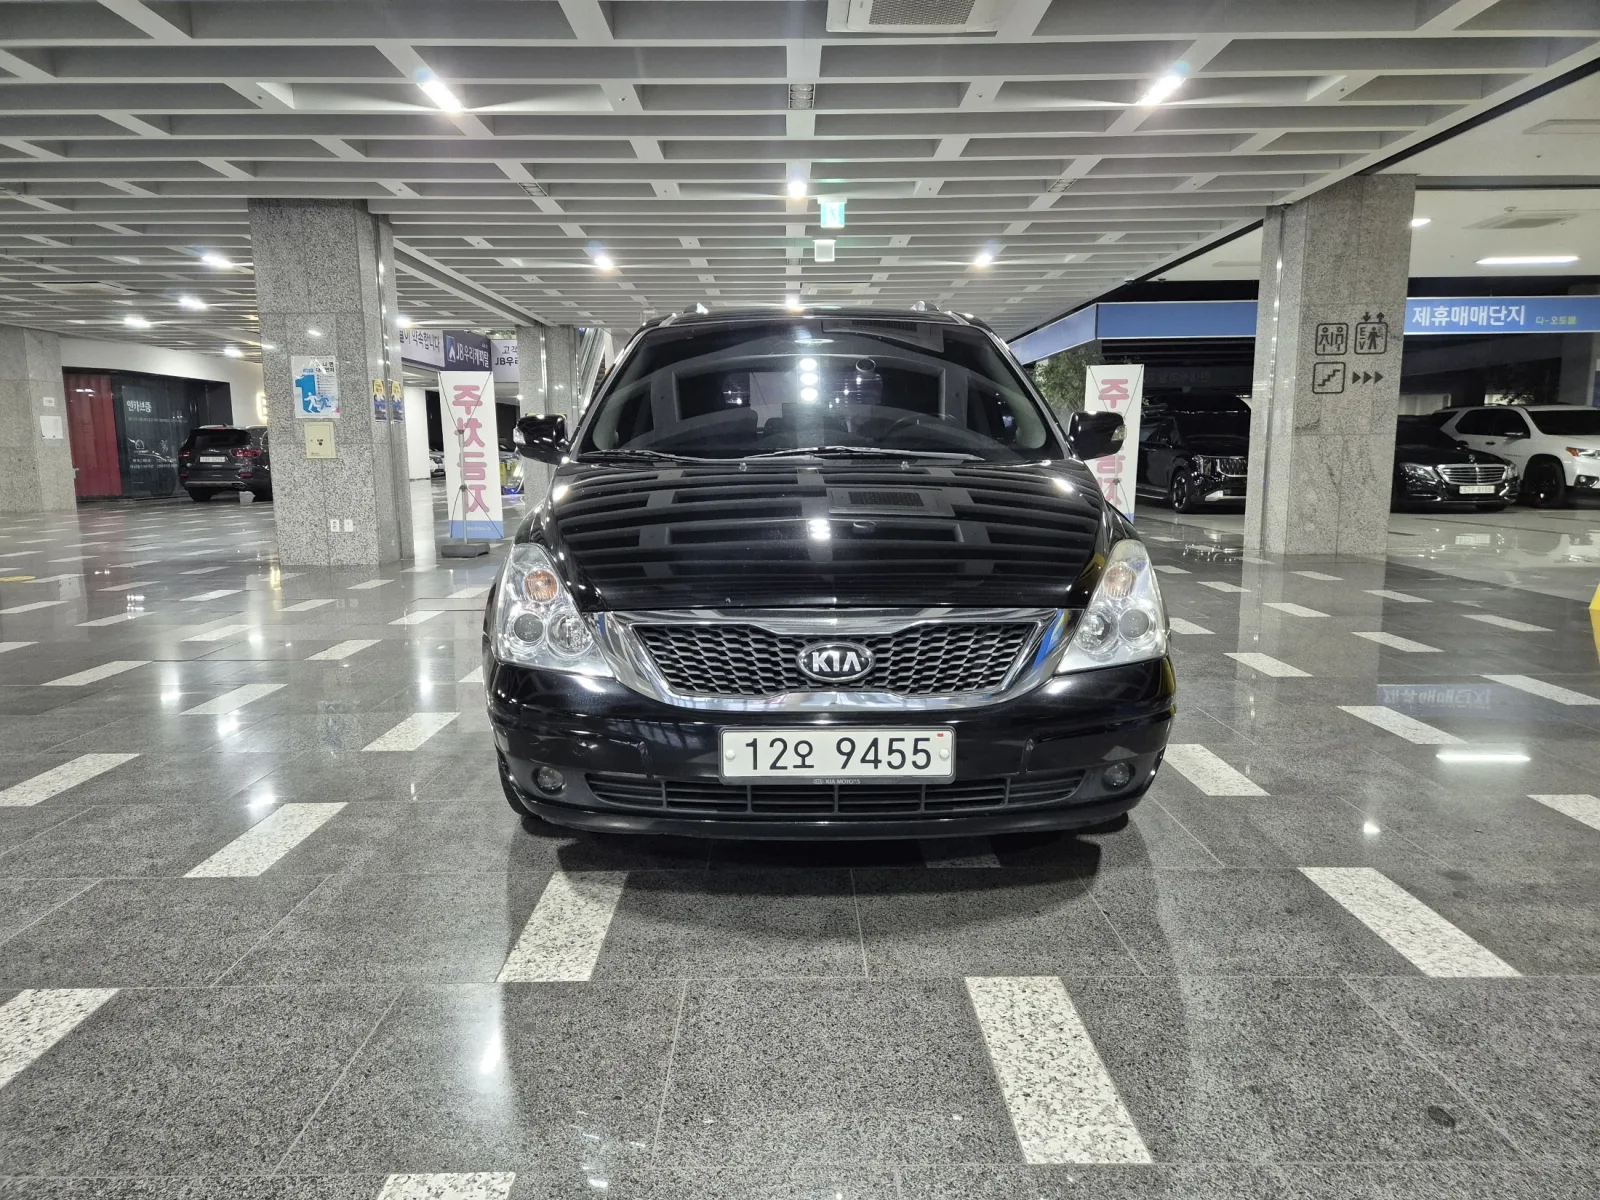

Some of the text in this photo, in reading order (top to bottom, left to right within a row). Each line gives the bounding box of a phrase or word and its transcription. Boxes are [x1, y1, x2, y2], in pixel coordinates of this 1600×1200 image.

[1412, 305, 1525, 327] 제휴매매단지
[812, 651, 862, 672] KIA
[745, 737, 932, 771] 12오 9455
